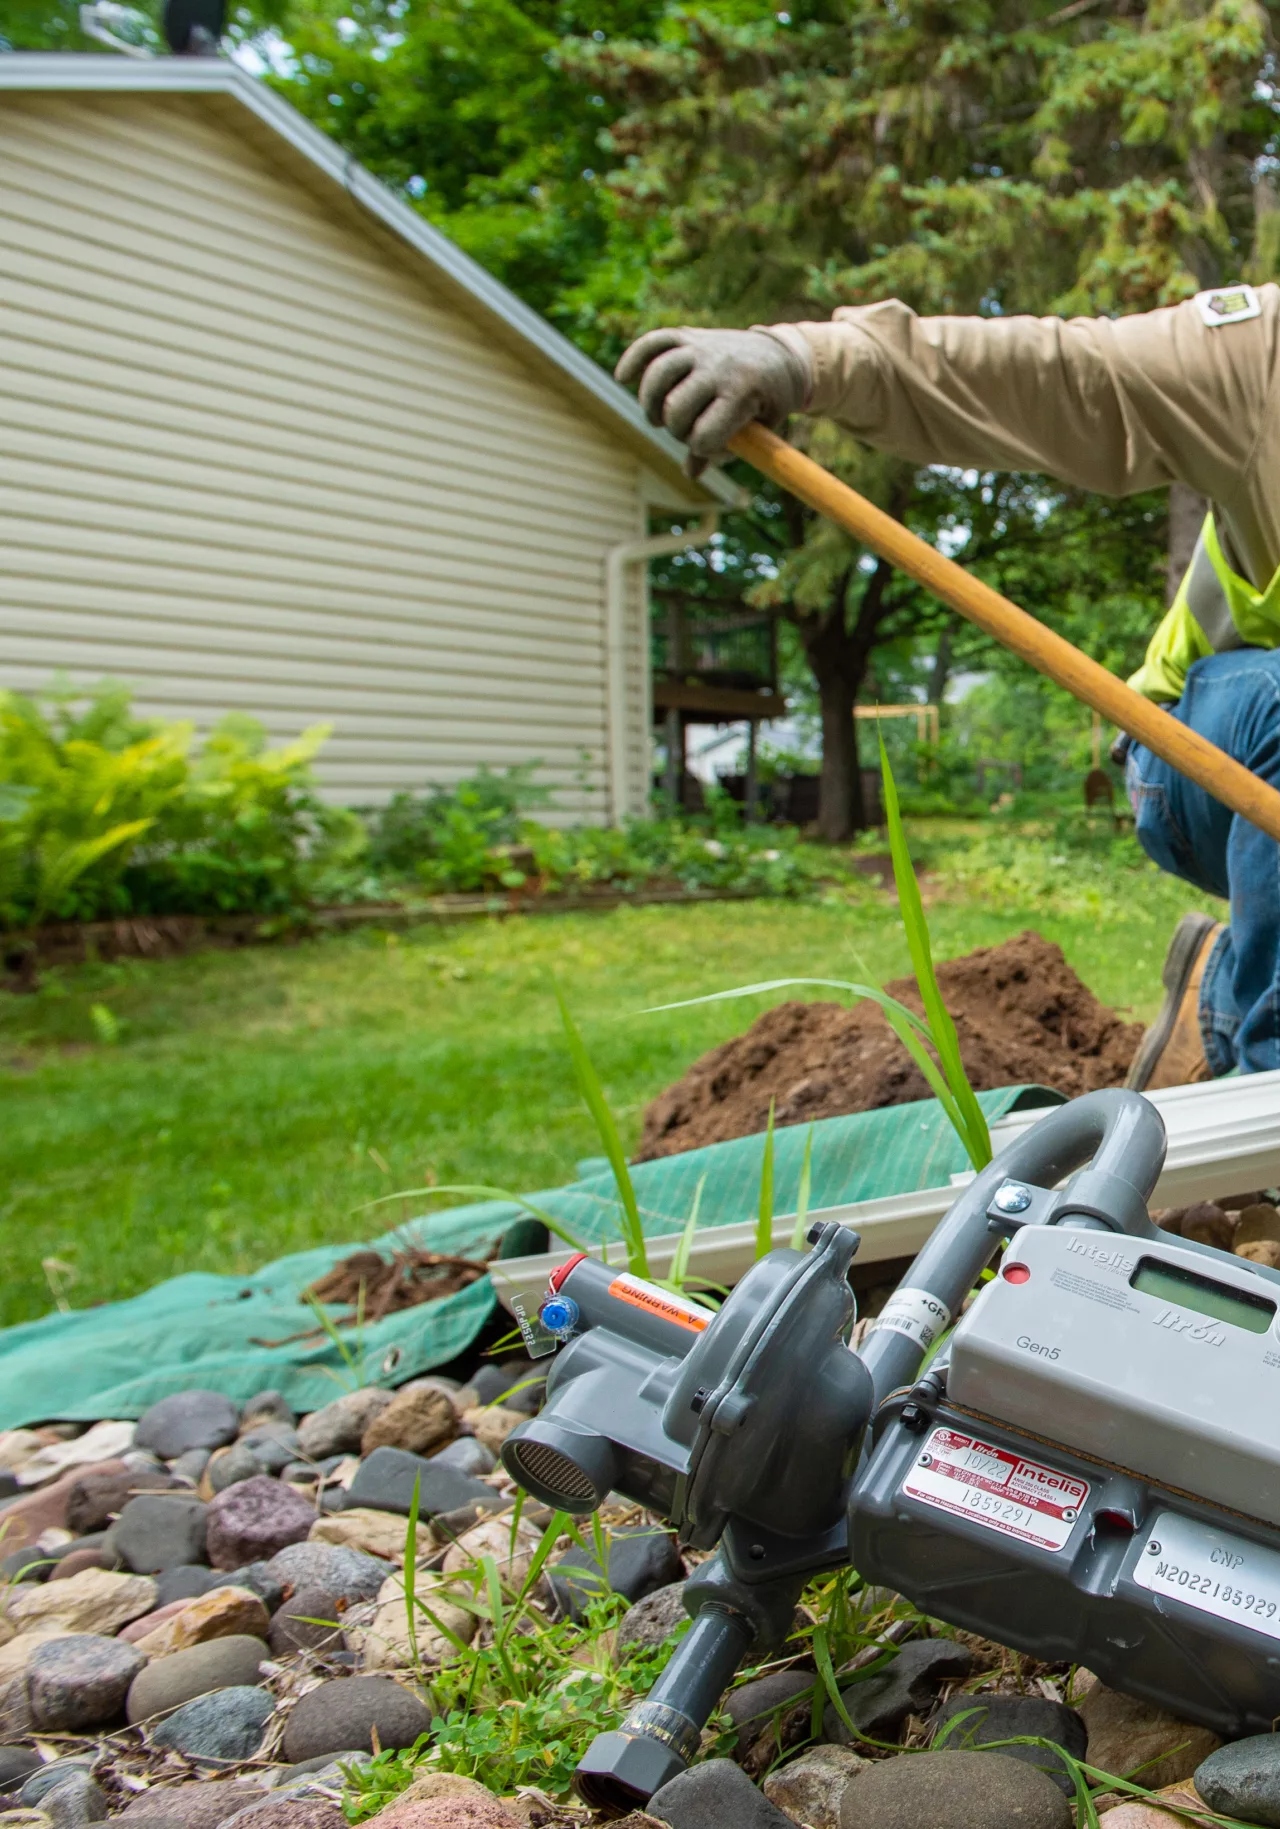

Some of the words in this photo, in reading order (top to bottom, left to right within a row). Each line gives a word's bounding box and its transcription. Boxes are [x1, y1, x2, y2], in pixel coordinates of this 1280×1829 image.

[1066, 1236, 1134, 1273] Intelis
[621, 1284, 680, 1317] WARNING
[1016, 1335, 1062, 1360] Gen5
[963, 1451, 1008, 1479] 10/22
[1010, 1481, 1037, 1495] ACCURACY
[1037, 1491, 1054, 1502] CLASS
[1017, 1463, 1082, 1497] Intelis
[1034, 1483, 1050, 1494] CLASS
[940, 1500, 965, 1513] Hazardous
[965, 1509, 989, 1523] Locations
[962, 1489, 1033, 1527] 1859291
[1209, 1547, 1245, 1570] CNP
